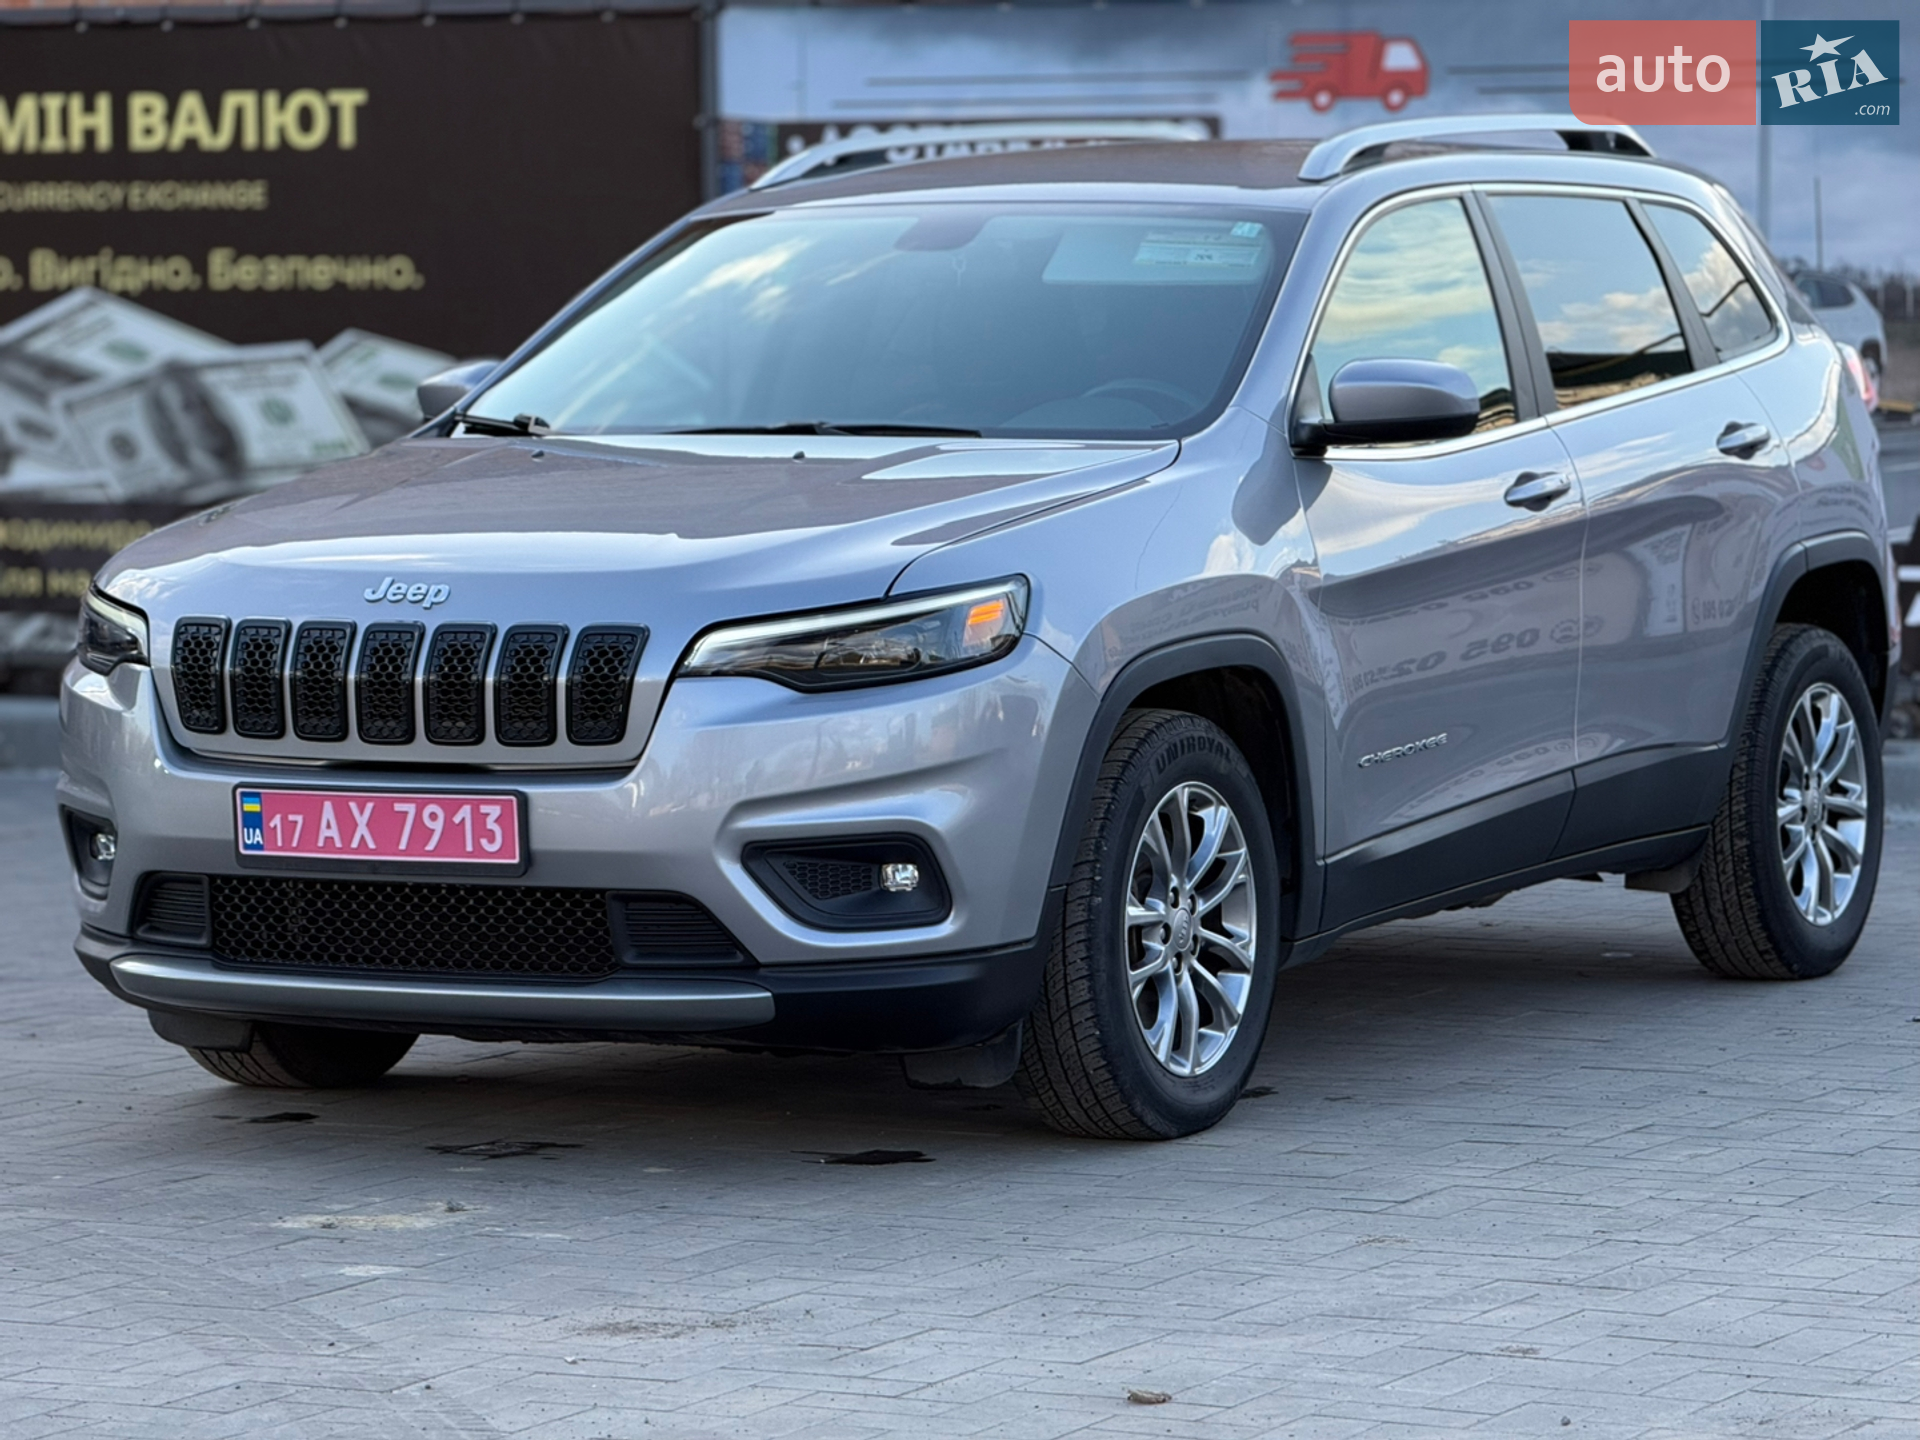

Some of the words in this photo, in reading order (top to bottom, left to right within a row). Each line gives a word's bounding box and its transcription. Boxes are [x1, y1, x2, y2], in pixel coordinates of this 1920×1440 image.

[127, 88, 369, 152] ВАЛЮТ
[126, 179, 268, 211] EXCHANGE
[207, 246, 425, 292] Безпечно.
[363, 576, 451, 611] Jeep
[1155, 736, 1231, 776] UNIROYAL
[1358, 732, 1448, 768] CHEROKEE
[243, 827, 263, 845] UA
[268, 813, 304, 848] 17
[316, 800, 377, 849] AX
[393, 802, 503, 852] 7913
